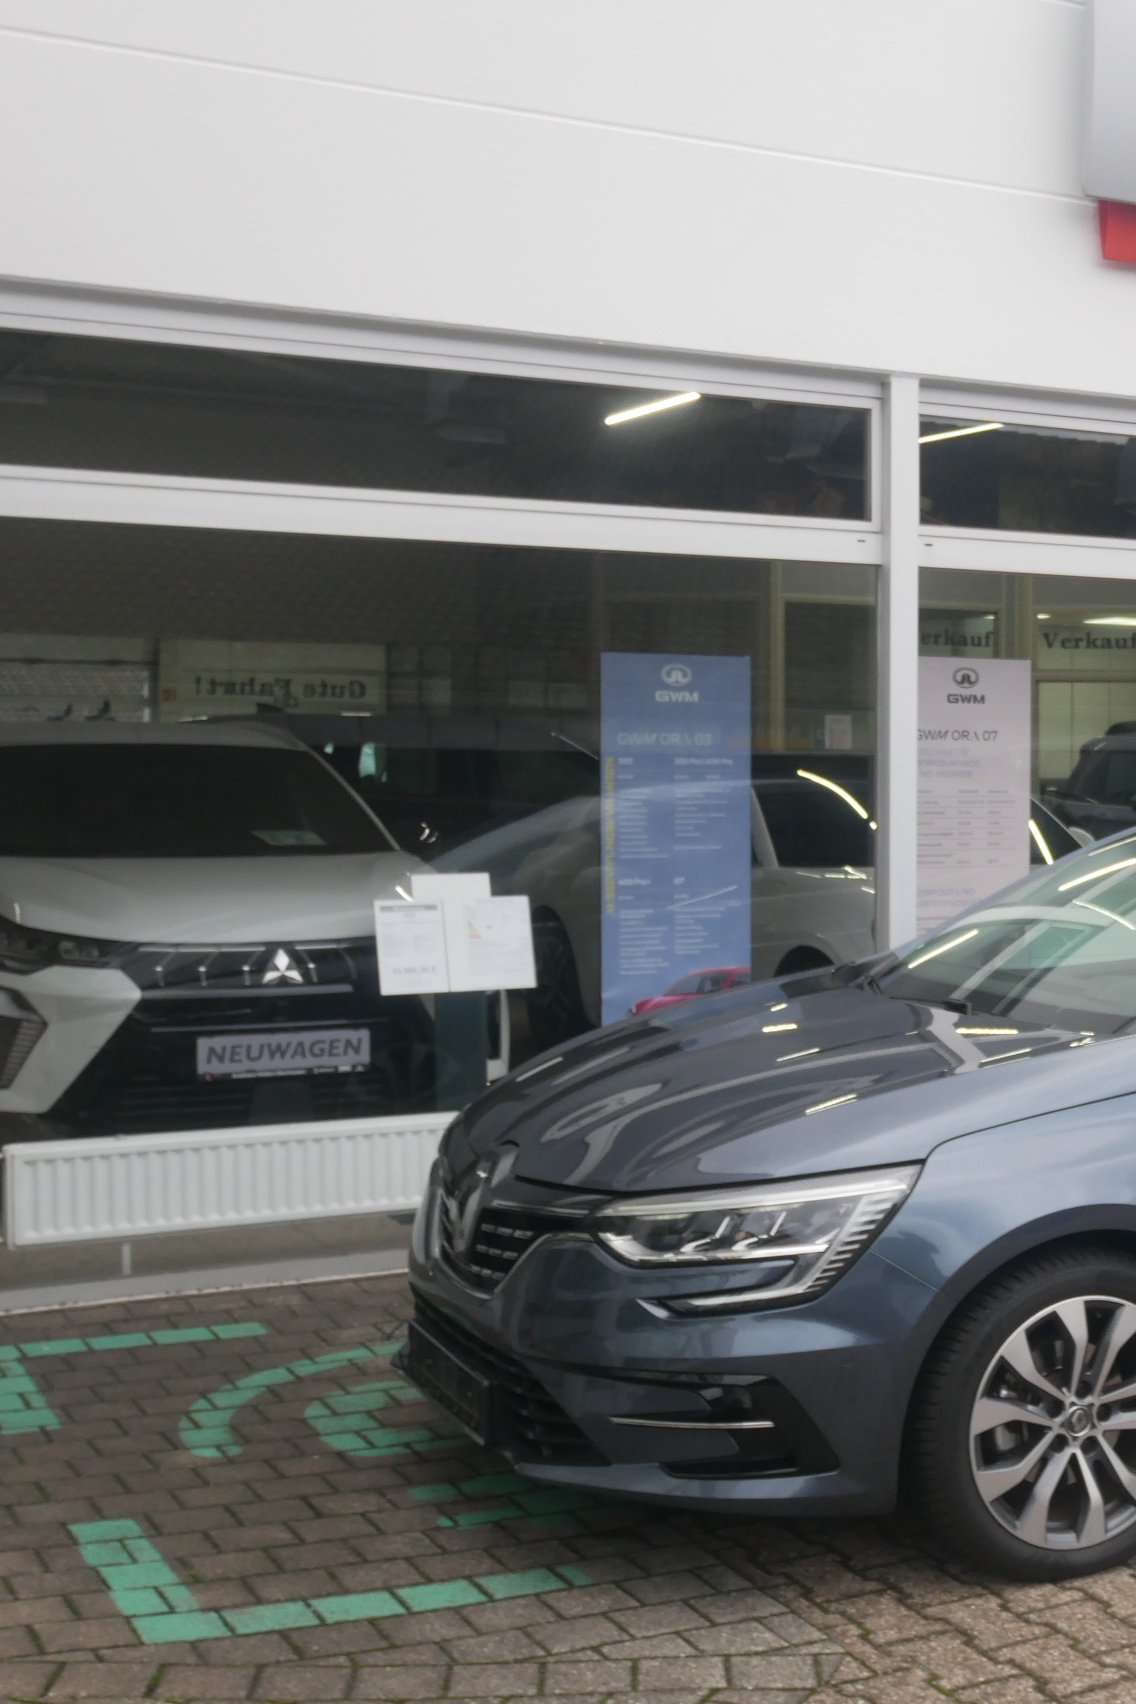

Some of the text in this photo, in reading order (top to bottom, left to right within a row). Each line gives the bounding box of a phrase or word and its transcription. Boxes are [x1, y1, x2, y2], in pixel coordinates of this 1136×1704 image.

[919, 630, 994, 649] erkauf
[655, 690, 700, 702] GWM
[946, 693, 986, 705] GWM
[983, 730, 999, 742] 07
[205, 1037, 363, 1065] NEUWAGEN
